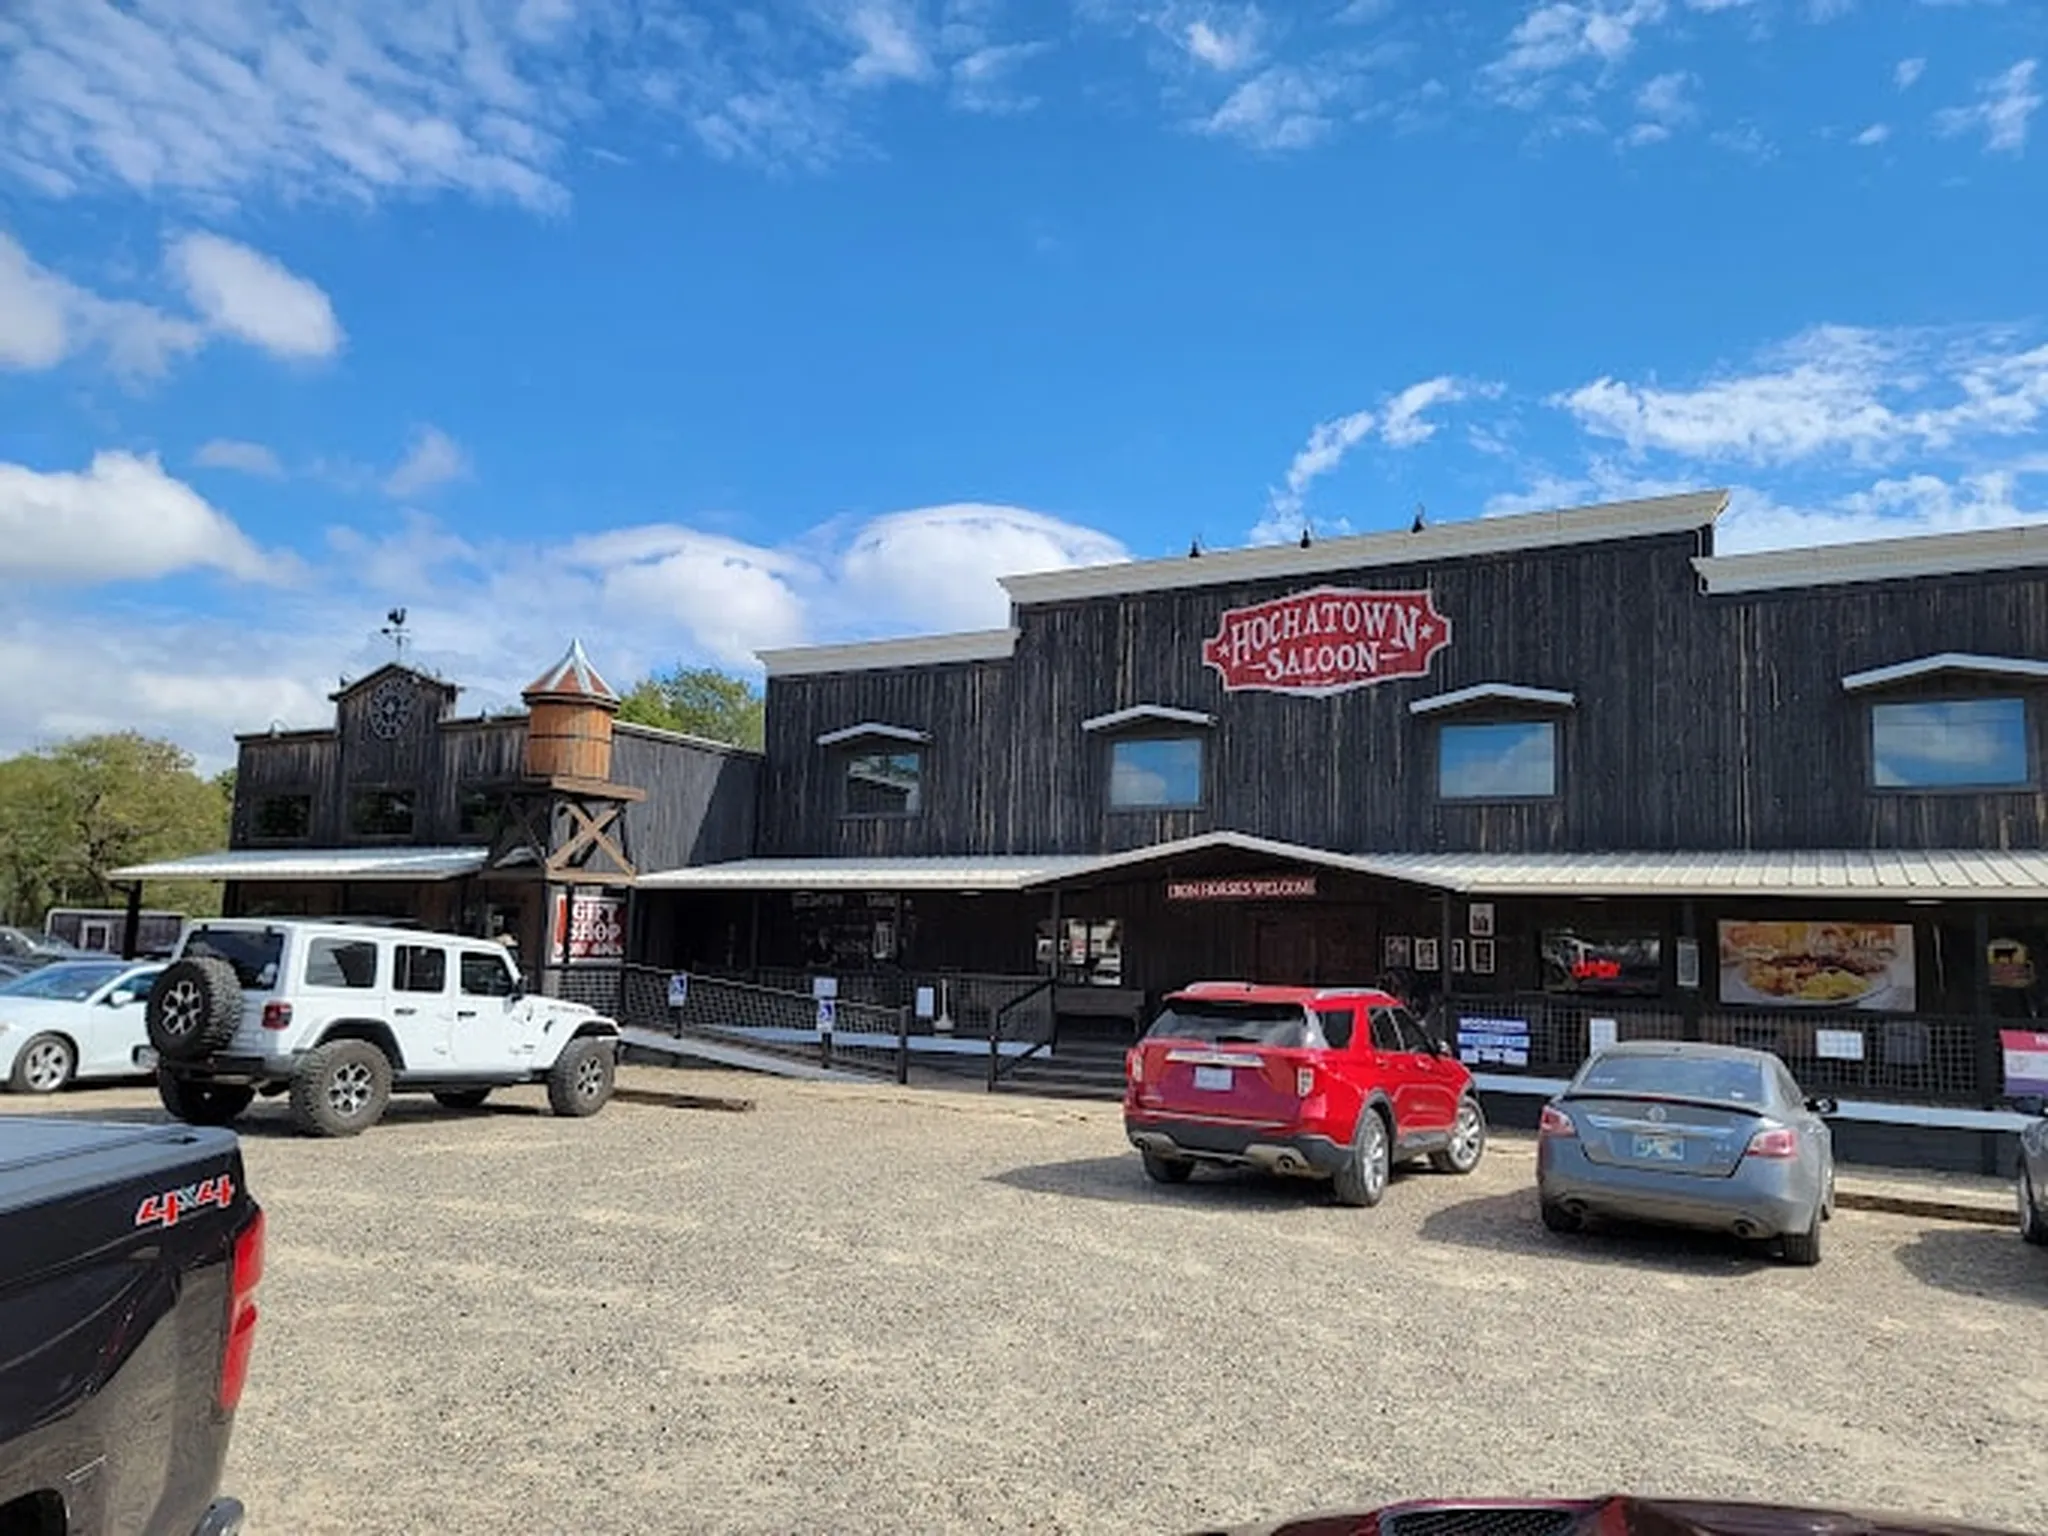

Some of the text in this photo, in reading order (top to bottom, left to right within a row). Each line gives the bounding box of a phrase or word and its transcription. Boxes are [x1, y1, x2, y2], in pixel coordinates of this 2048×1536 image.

[1230, 601, 1422, 667] HOCHATOWN
[1264, 640, 1381, 681] SALOON
[1167, 878, 1317, 899] IRON HORSES WELCOME
[571, 901, 618, 921] GIFT
[571, 921, 621, 941] SHOP
